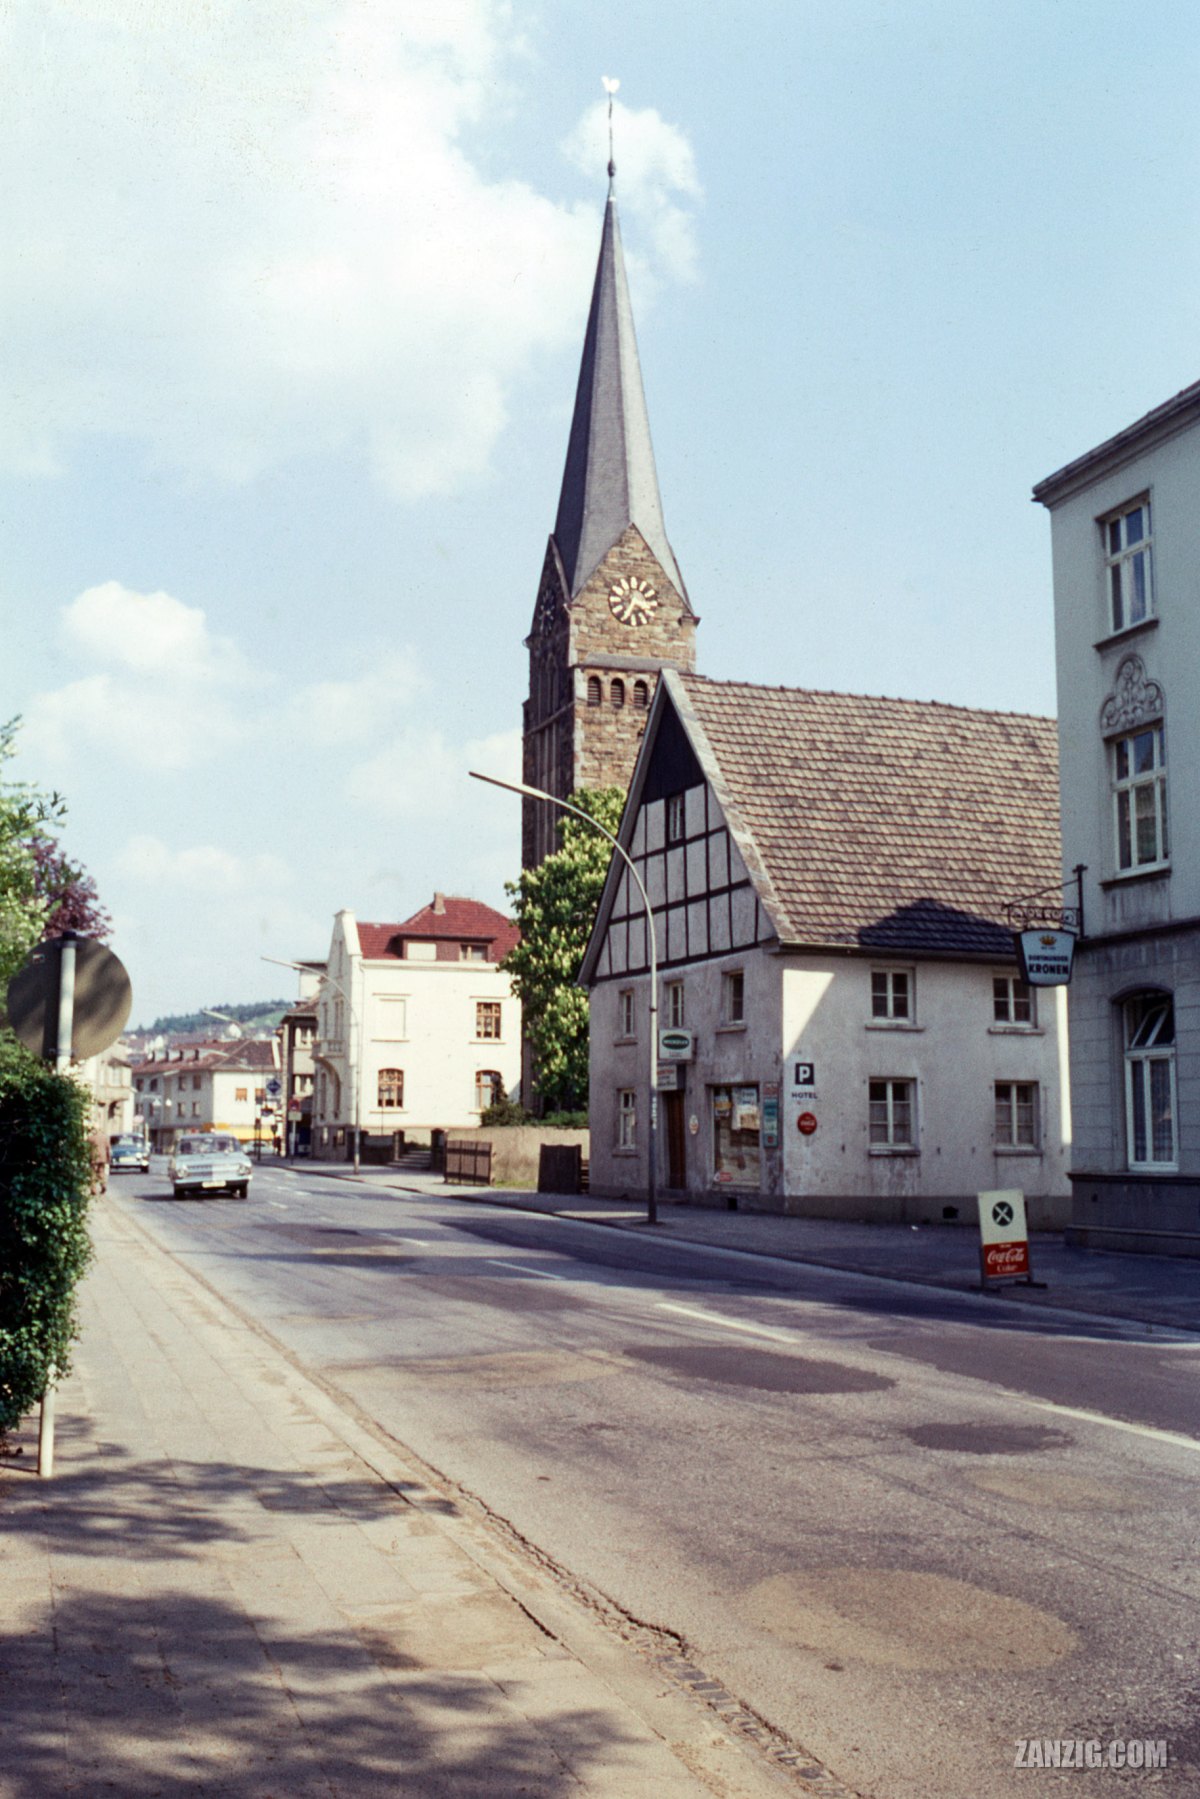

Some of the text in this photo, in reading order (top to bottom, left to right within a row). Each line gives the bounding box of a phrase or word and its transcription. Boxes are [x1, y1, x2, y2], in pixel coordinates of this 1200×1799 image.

[1028, 964, 1069, 974] KRONEN
[799, 1066, 811, 1083] P
[791, 1091, 818, 1099] HOTEL
